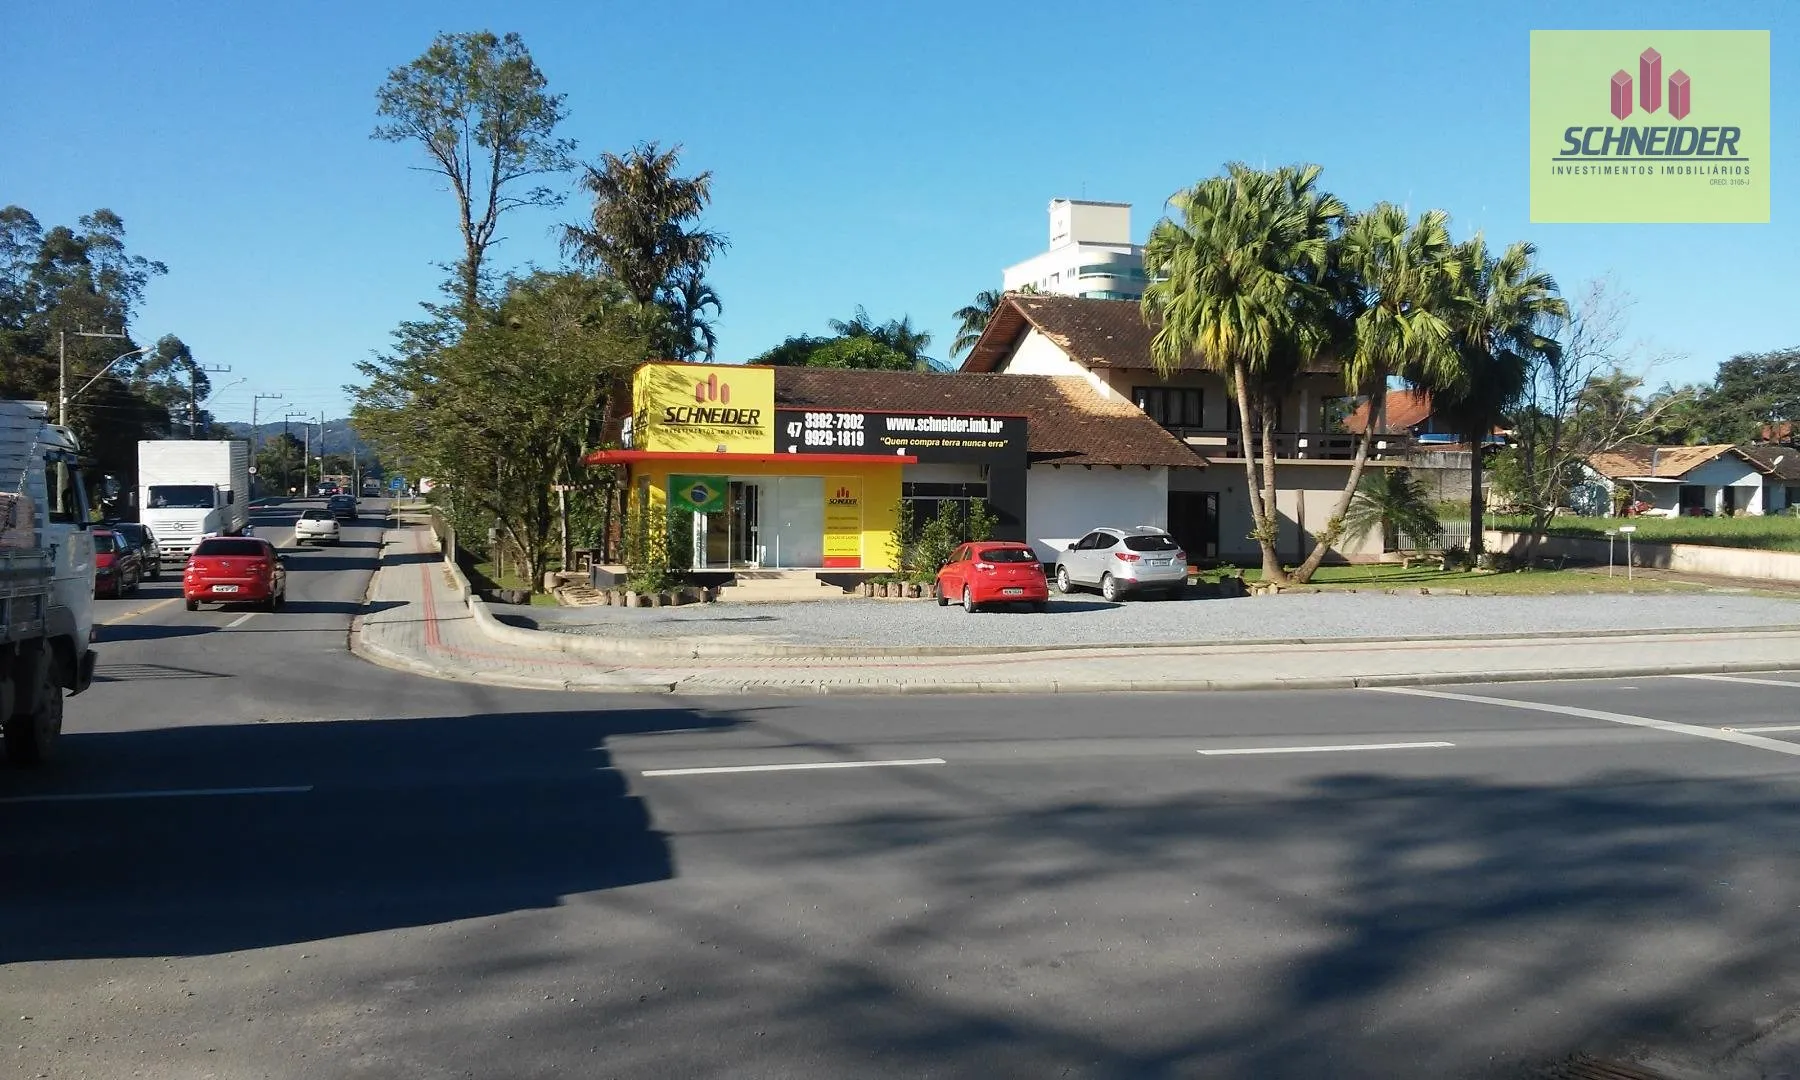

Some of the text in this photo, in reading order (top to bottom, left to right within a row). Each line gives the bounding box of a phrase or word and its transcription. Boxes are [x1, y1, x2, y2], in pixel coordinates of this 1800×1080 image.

[663, 407, 761, 425] SCHNEIDER
[886, 416, 1003, 433] www.schneider.imb.br
[786, 422, 803, 438] 47
[804, 430, 865, 447] 9929-1819
[910, 439, 940, 448] compra
[941, 438, 960, 447] terra
[962, 440, 986, 448] nunca
